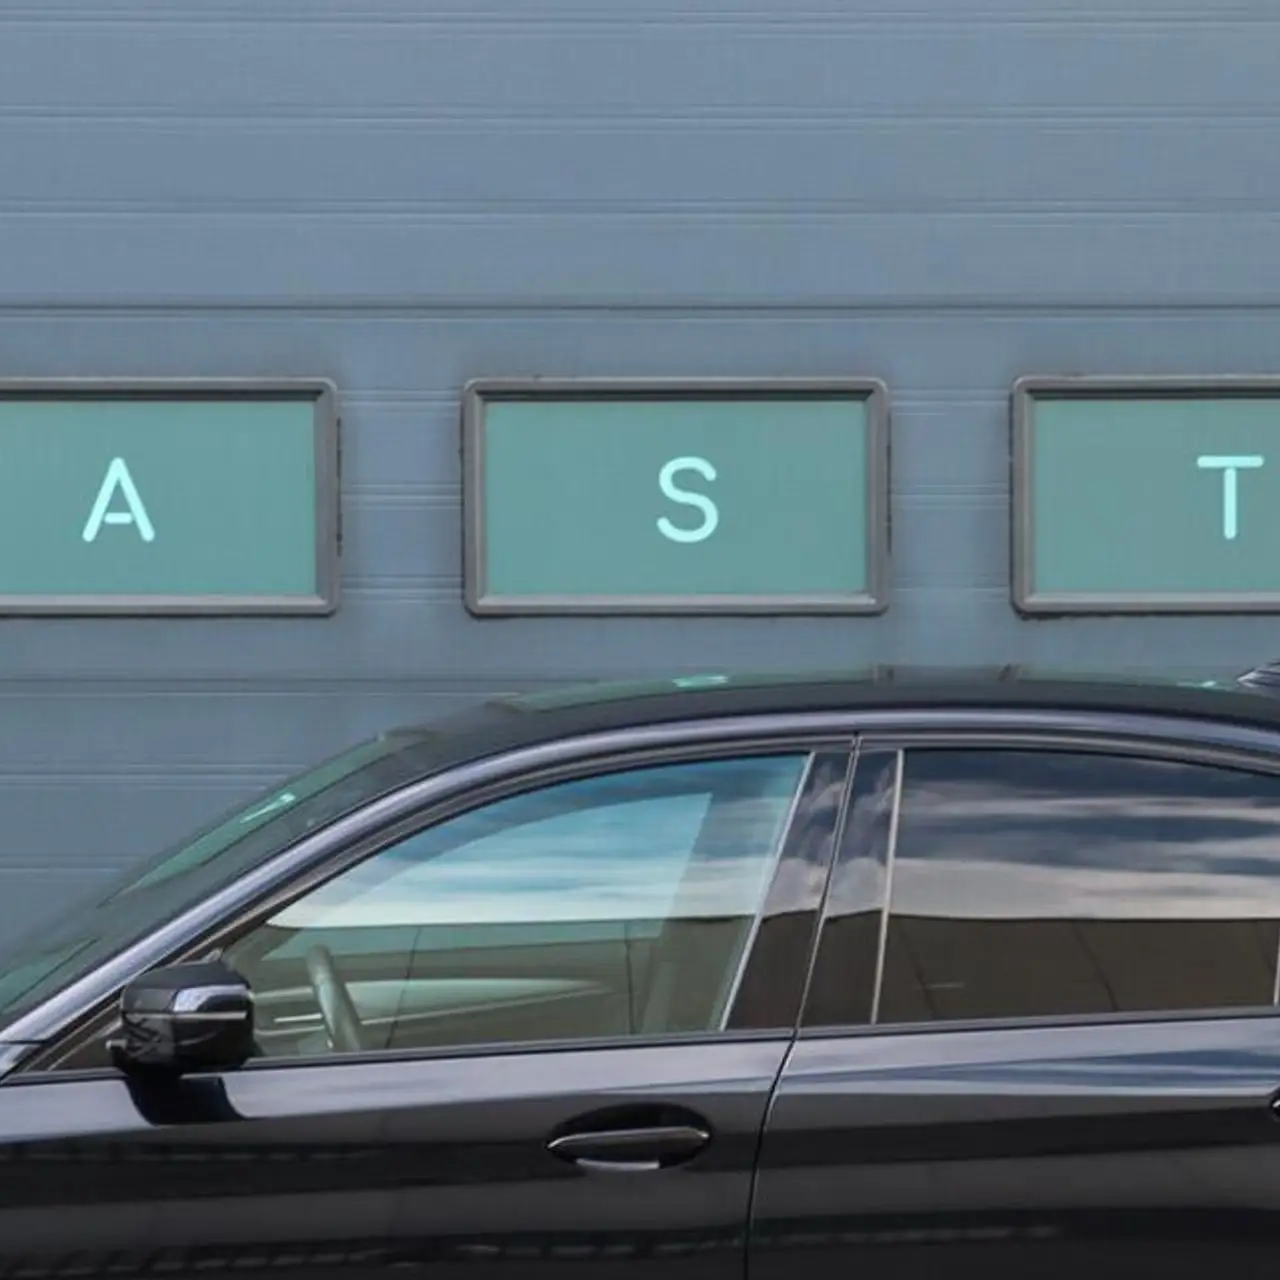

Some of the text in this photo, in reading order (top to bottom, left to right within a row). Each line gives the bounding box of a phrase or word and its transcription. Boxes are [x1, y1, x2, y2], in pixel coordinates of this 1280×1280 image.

[82, 456, 155, 542] A
[656, 456, 720, 543] S
[1197, 455, 1265, 540] T
